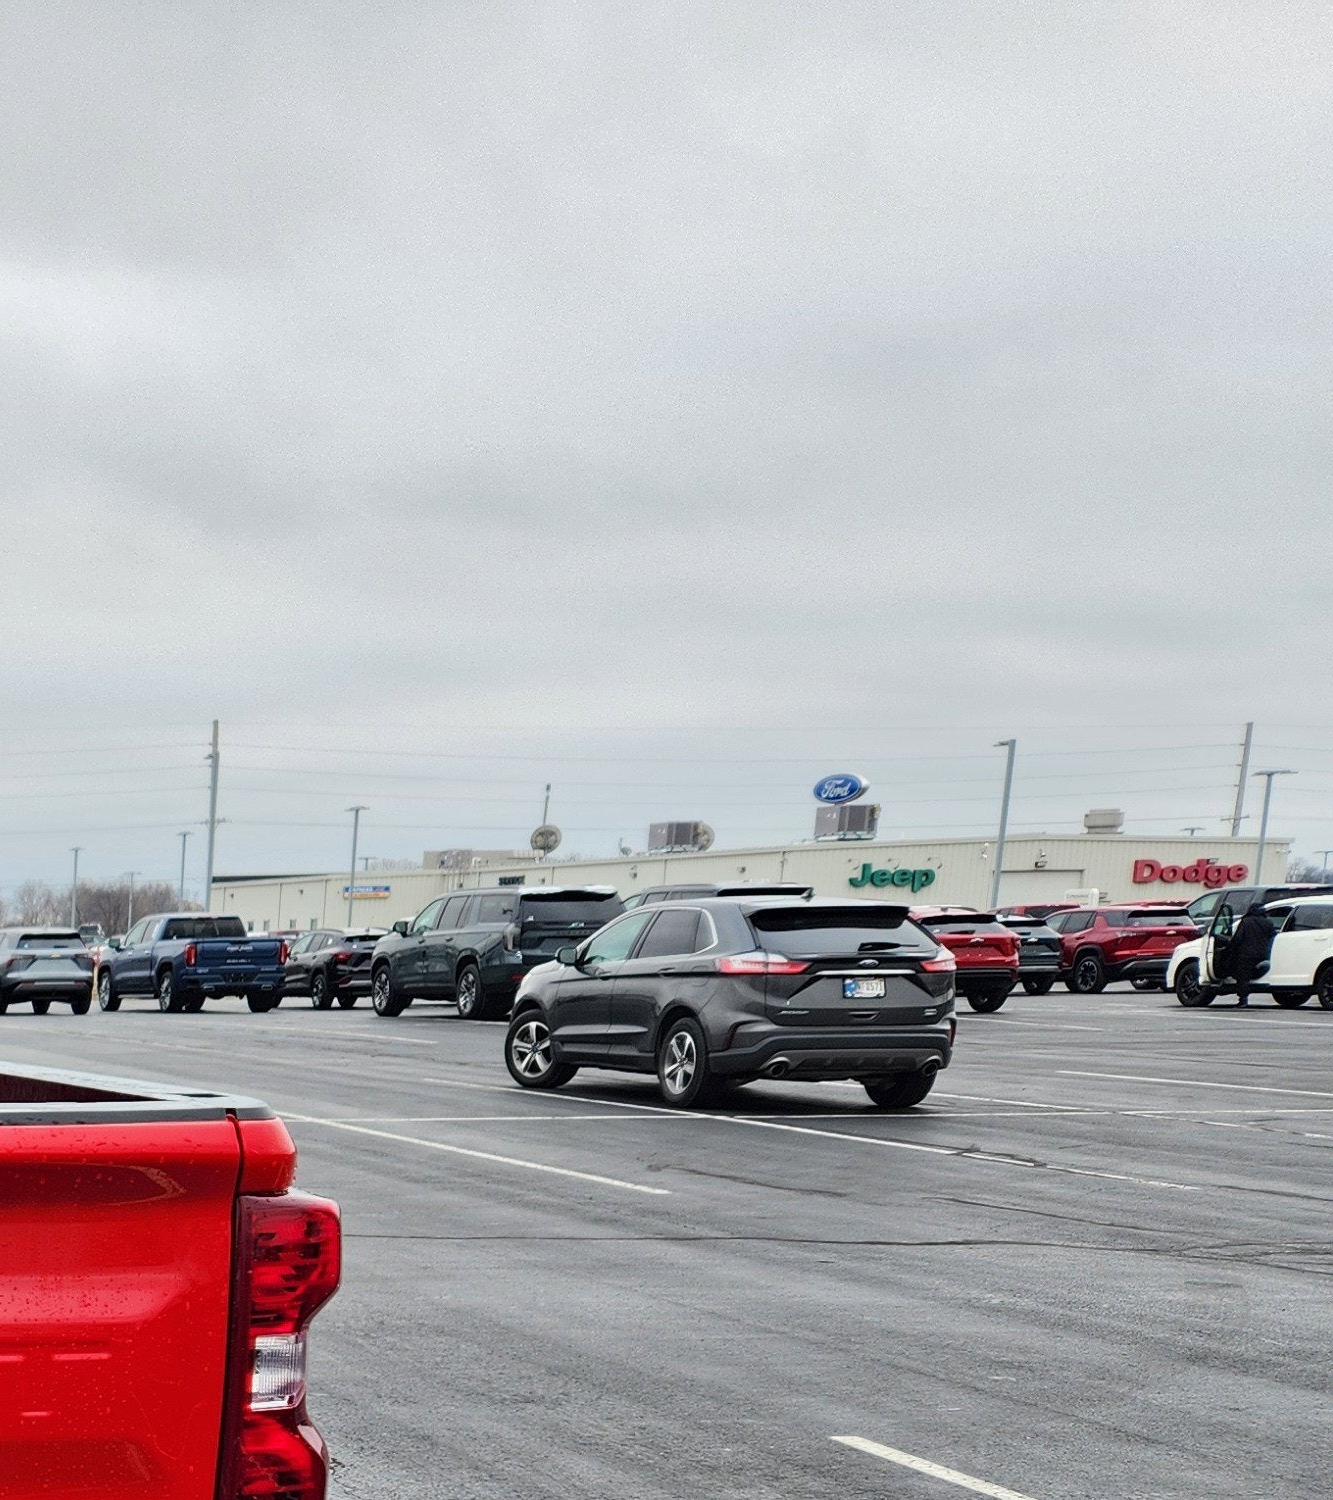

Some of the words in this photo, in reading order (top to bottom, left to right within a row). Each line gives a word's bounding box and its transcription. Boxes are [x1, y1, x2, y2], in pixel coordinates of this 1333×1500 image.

[821, 779, 852, 799] Ford
[848, 863, 936, 893] Jeep
[1133, 859, 1249, 888] Dodge
